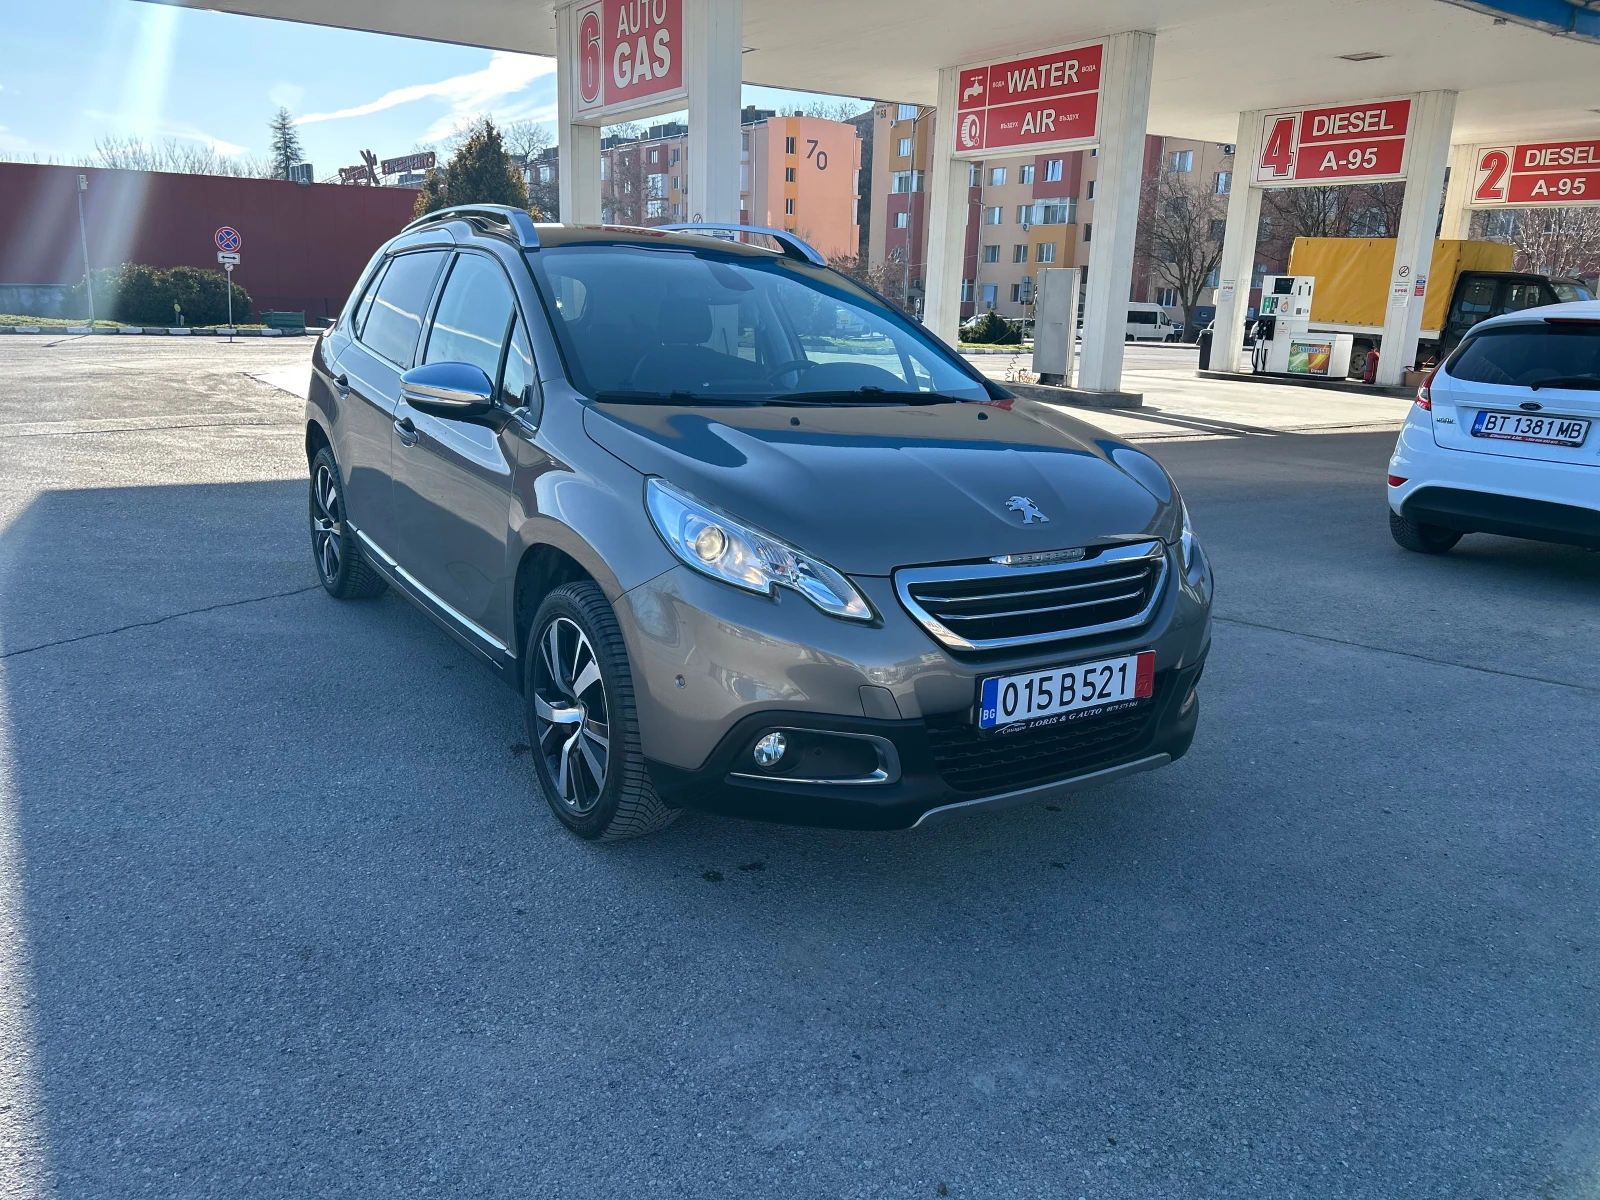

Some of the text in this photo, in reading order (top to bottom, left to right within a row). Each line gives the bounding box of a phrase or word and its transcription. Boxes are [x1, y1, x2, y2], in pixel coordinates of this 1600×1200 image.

[616, 0, 667, 39] AUTO
[579, 11, 601, 103] 6
[613, 28, 671, 89] GAS
[1007, 59, 1079, 94] WATER
[1081, 64, 1096, 73] ВОДА
[1020, 108, 1056, 135] AIR
[1059, 112, 1080, 122] ВЪЗДУХ
[1312, 109, 1394, 137] DIESEL
[806, 139, 828, 171] 70
[1260, 116, 1295, 177] 4
[1318, 147, 1378, 173] A-95
[1524, 146, 1600, 167] DIESEL
[1475, 149, 1509, 200] 2
[1530, 177, 1587, 197] A-95
[1514, 417, 1555, 436] 1381
[1018, 550, 1076, 562] PEUGEOT
[982, 708, 996, 721] BG
[1029, 716, 1058, 728] LORIS
[1076, 708, 1102, 719] AUTO
